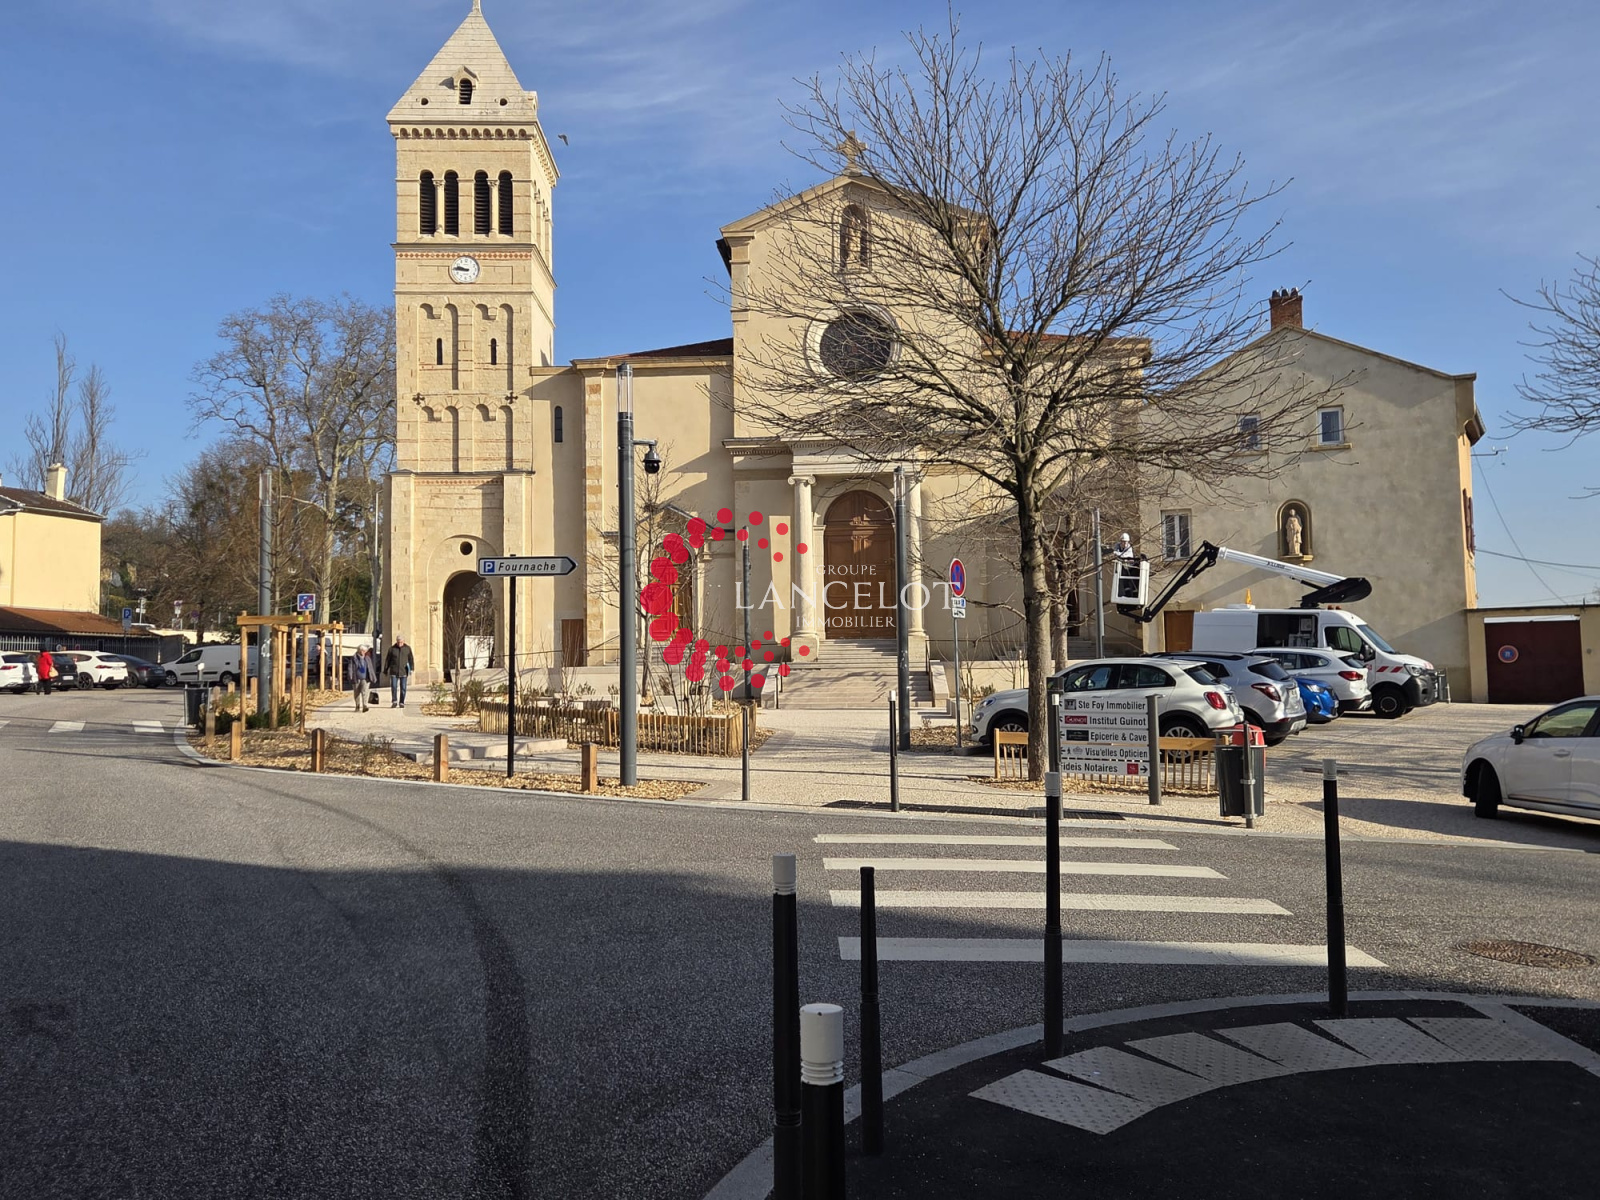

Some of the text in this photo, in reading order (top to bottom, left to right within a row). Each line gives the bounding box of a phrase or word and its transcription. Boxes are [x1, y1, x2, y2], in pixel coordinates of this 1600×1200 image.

[485, 562, 556, 571] P Fournache
[1078, 700, 1146, 711] Ste Foy Immobilier
[1089, 716, 1146, 726] Institut Guinot
[1090, 732, 1119, 741] Epicerie
[1121, 733, 1127, 741] &
[1129, 733, 1147, 741] Cave
[1085, 747, 1148, 758] Visu'elles Opticien
[1084, 763, 1118, 772] Notaires
